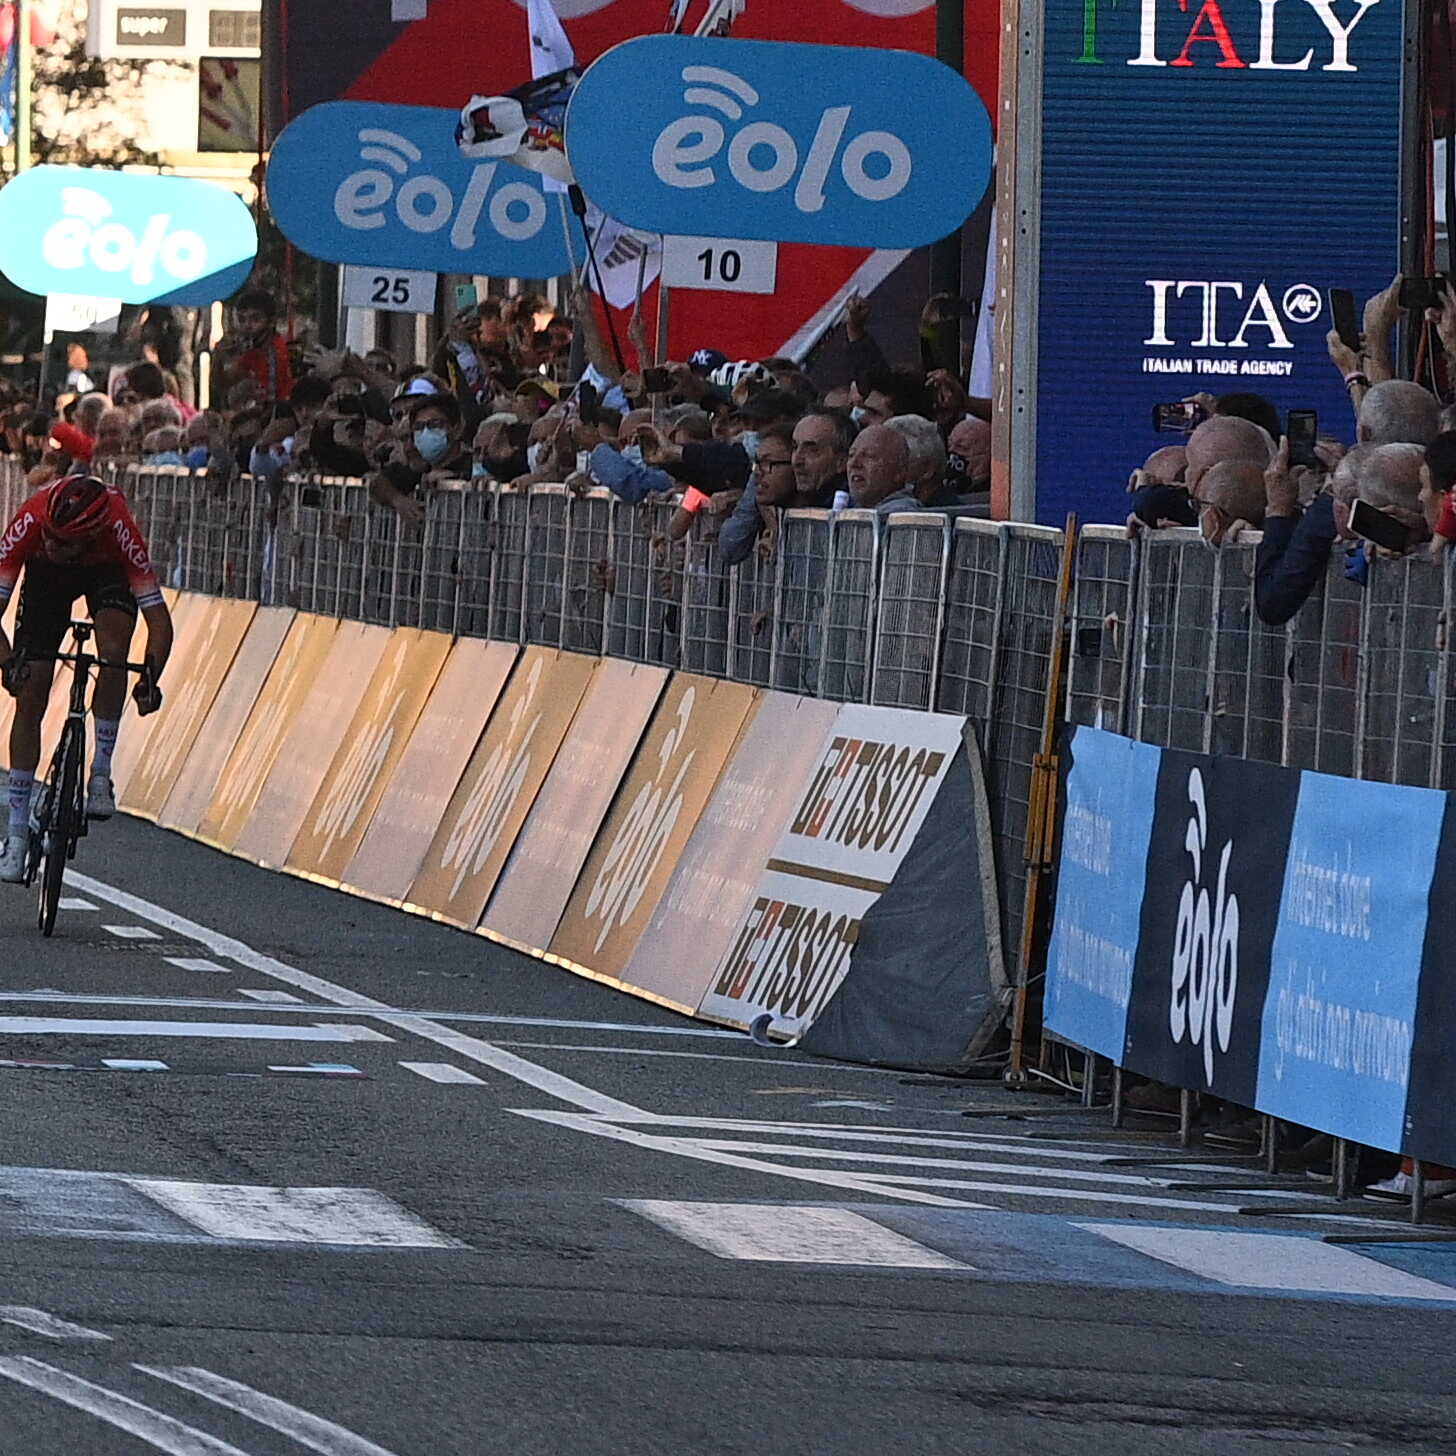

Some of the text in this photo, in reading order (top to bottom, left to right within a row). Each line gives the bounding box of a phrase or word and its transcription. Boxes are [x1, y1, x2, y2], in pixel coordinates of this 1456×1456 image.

[334, 159, 547, 249] eolo
[653, 106, 911, 213] eolo
[44, 213, 206, 285] eolo
[372, 276, 411, 304] 25
[697, 249, 742, 283] 10
[1143, 279, 1294, 349] ITA
[1143, 357, 1293, 376] ITALIAN TRADE AGENCY
[442, 713, 543, 901] eolo
[827, 741, 945, 854] TISSOT
[585, 749, 695, 954] eolo
[748, 904, 862, 1022] TISSOT
[1171, 840, 1240, 1086] eolo
